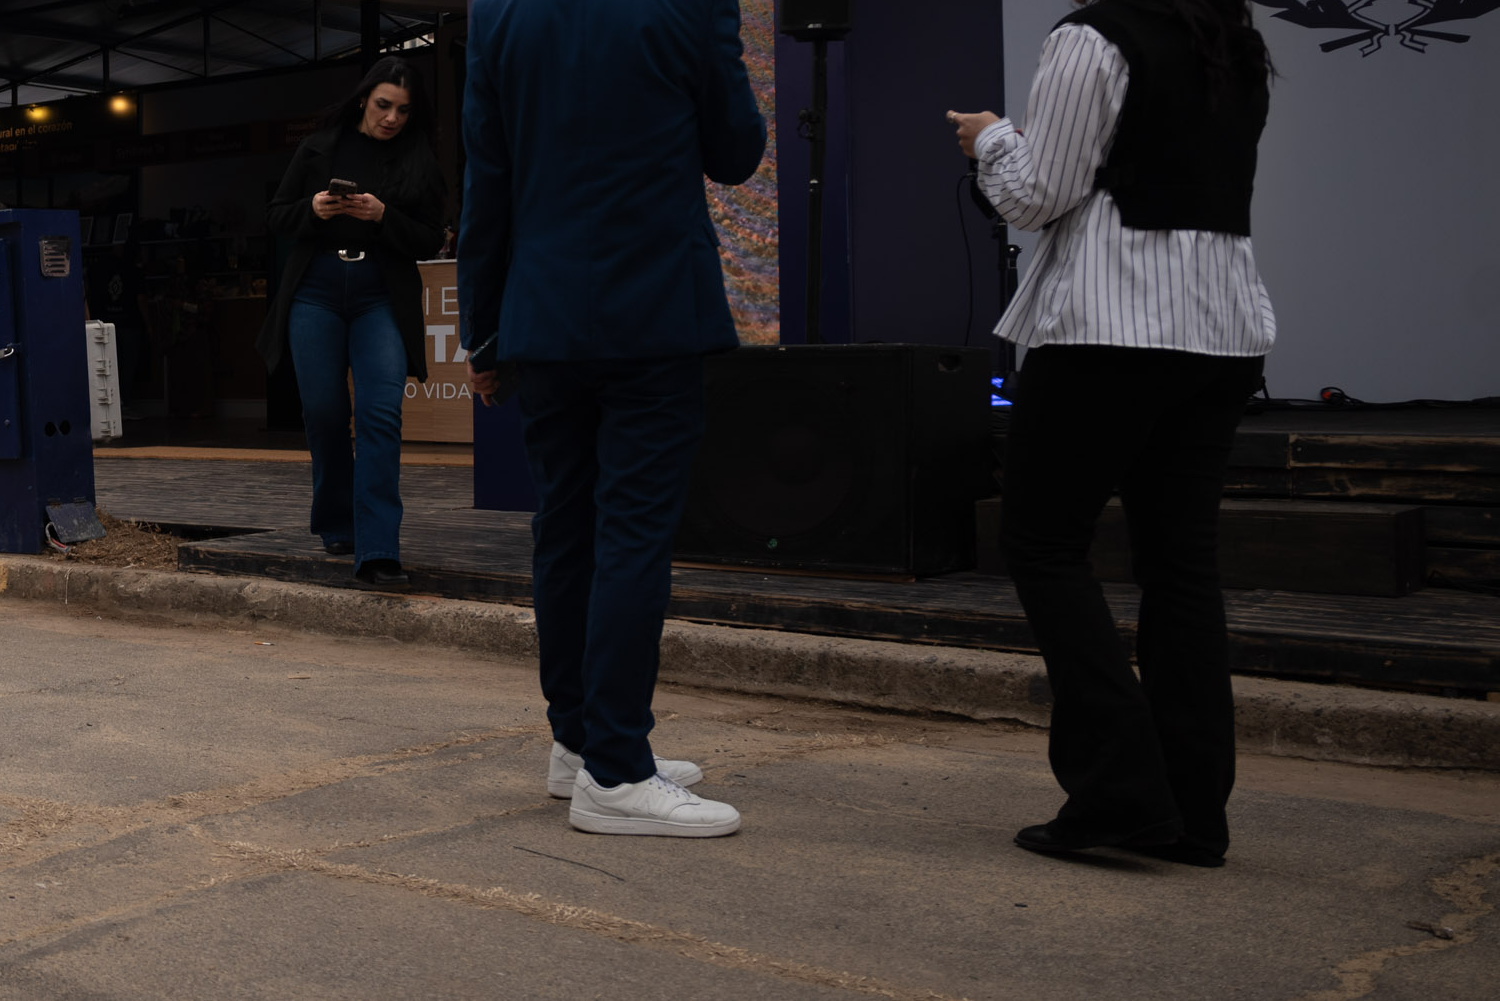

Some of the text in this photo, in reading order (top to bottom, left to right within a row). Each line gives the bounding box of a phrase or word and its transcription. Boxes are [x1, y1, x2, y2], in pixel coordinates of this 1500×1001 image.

[15, 127, 26, 137] en
[28, 124, 35, 134] el
[37, 120, 73, 134] corazón
[423, 383, 472, 399] VIDA
